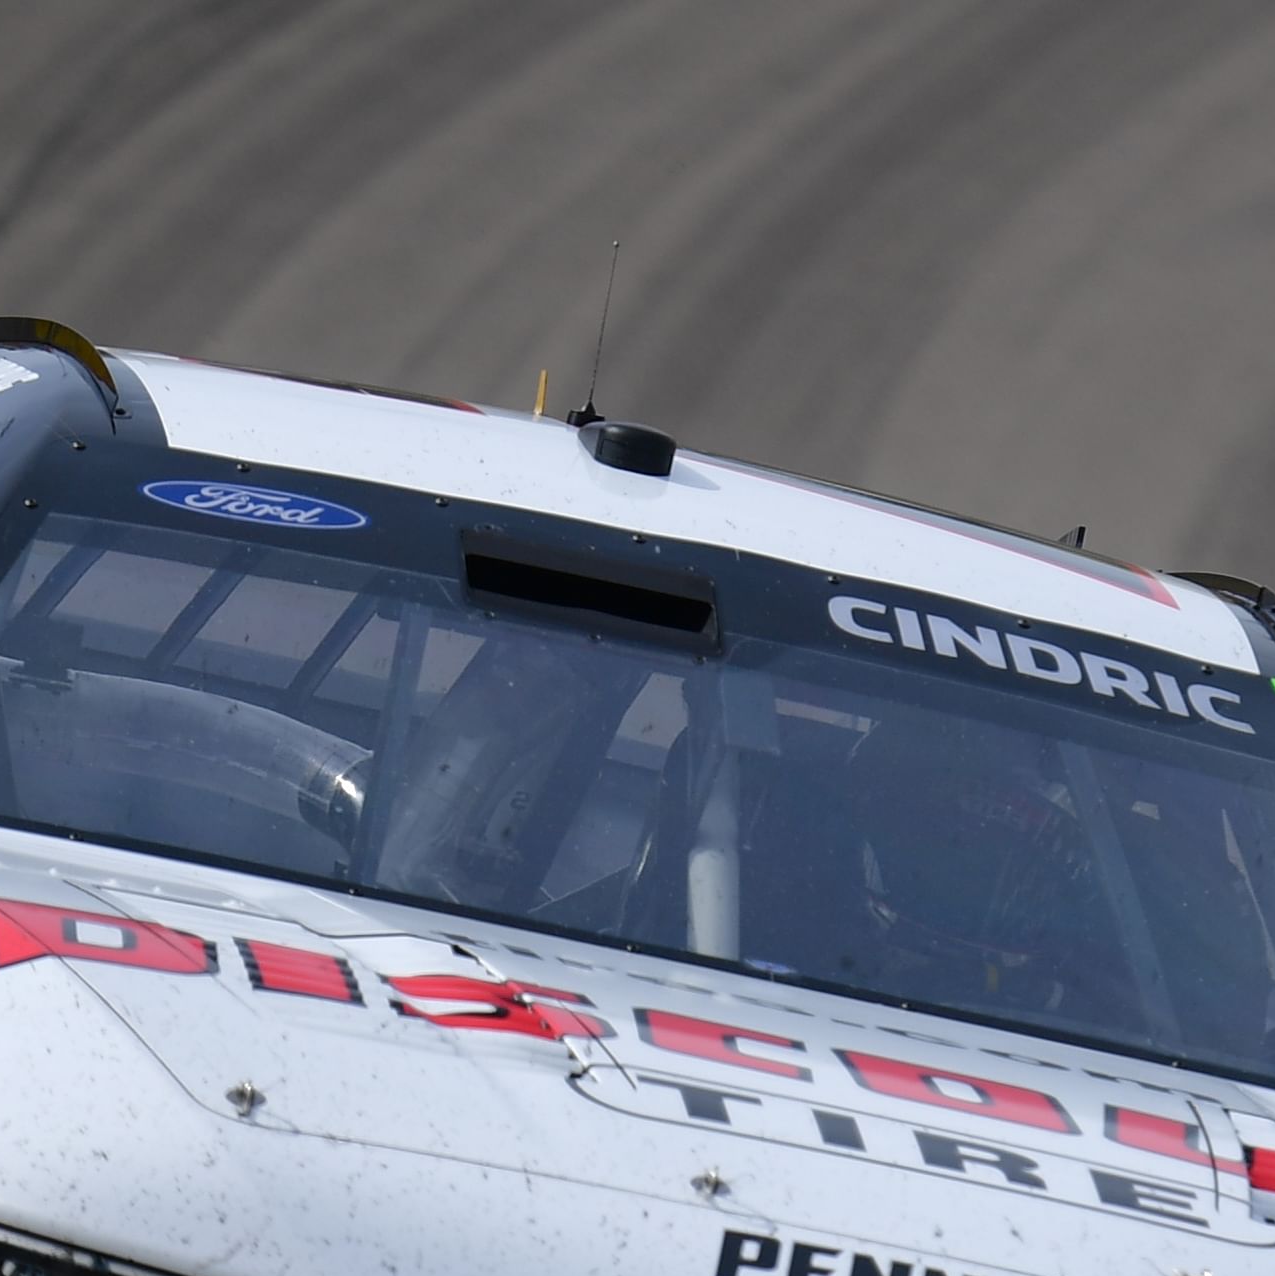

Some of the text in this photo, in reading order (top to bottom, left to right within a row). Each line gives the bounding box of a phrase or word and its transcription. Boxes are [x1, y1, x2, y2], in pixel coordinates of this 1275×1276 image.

[183, 484, 326, 525] Ford
[827, 595, 1257, 736] CINDRIC
[631, 1073, 1212, 1230] TIRE
